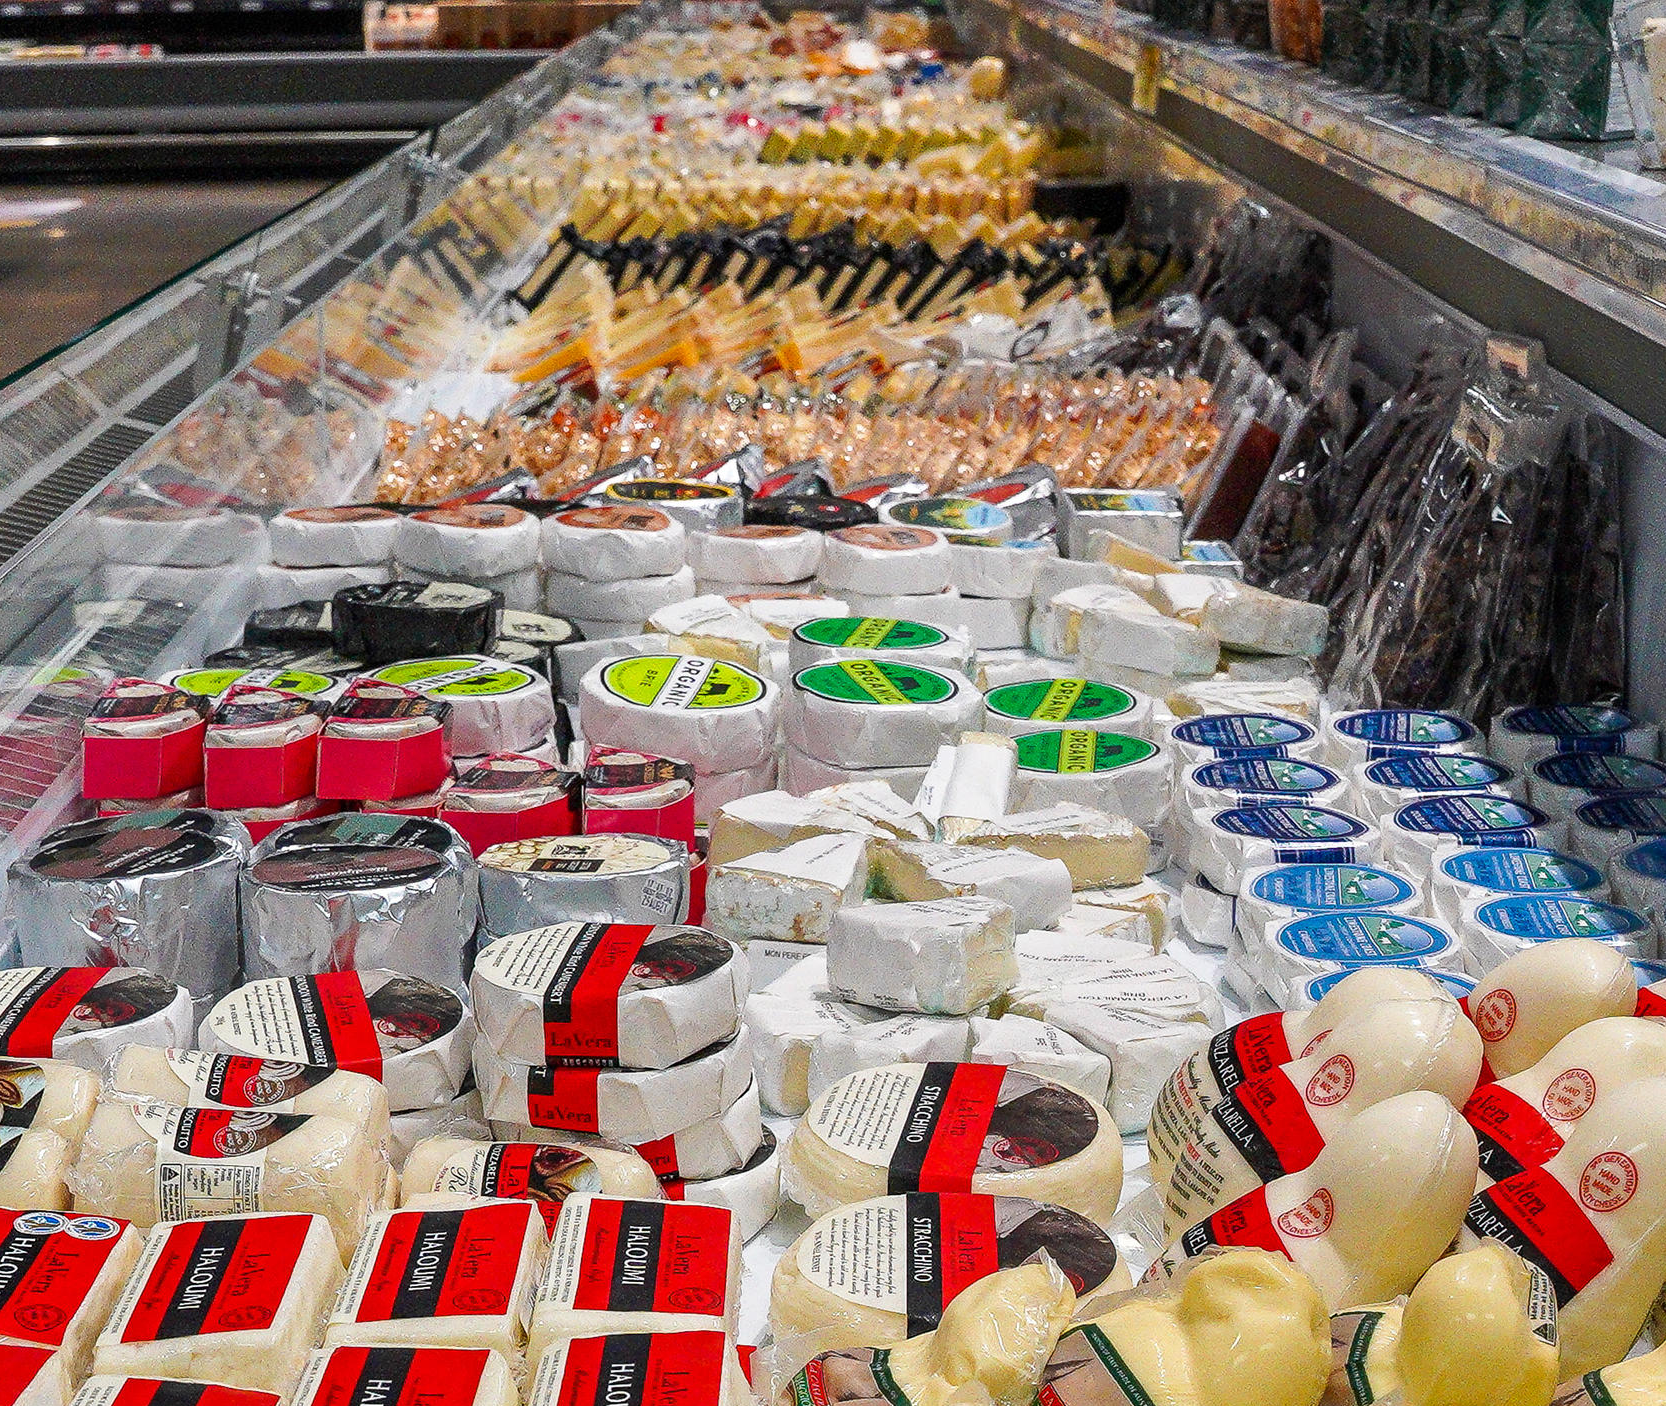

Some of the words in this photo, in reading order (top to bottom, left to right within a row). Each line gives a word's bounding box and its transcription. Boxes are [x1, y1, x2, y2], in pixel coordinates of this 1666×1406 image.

[642, 666, 660, 690] BRIE
[664, 655, 703, 711] ORGANIC
[850, 656, 900, 706] ORGANIC
[1042, 676, 1079, 724] ORGANIC
[1067, 729, 1089, 772] ORGANIC
[764, 949, 780, 958] MON
[308, 1027, 329, 1068] CAMEMBERT
[552, 1033, 612, 1048] LaVera
[209, 1054, 229, 1096] ROSCIUTTO
[1562, 1085, 1581, 1097] HAND
[178, 1108, 197, 1149] ROSCIUTTO
[535, 1104, 591, 1122] LaVera
[906, 1085, 941, 1143] STRACCHINO
[484, 1144, 503, 1195] OZZARELLA
[1592, 1179, 1614, 1197] MADE
[1598, 1168, 1621, 1186] HAND
[408, 1232, 447, 1291] HALOUMI
[622, 1225, 651, 1285] HALOUMI
[914, 1217, 933, 1281] STRACCHINO
[178, 1247, 224, 1310] HALOUMI
